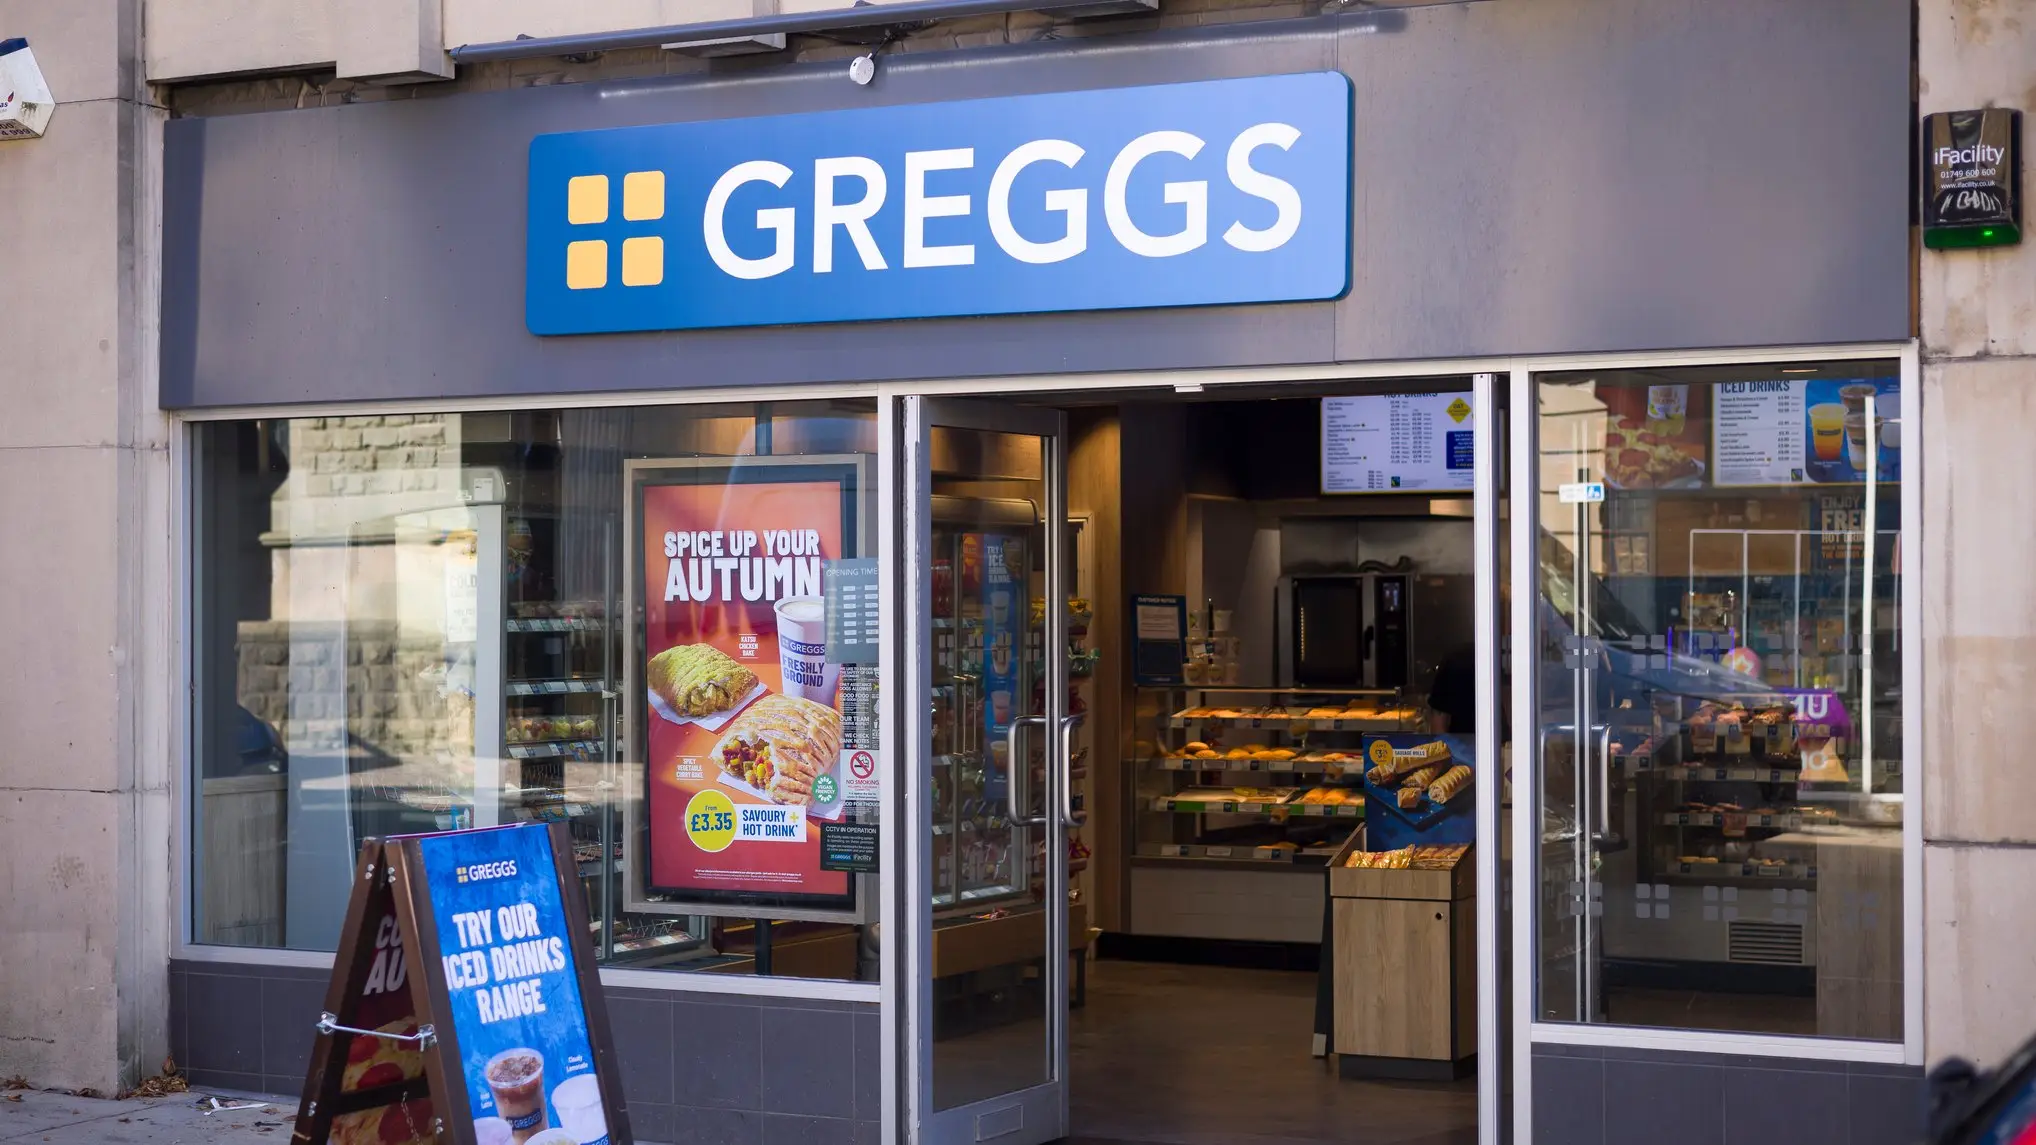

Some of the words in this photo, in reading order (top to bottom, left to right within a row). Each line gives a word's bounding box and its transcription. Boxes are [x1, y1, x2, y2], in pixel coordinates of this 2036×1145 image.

[1934, 145, 2004, 165] iFacility
[1940, 169, 1964, 179] 01749
[1965, 169, 1980, 178] 600
[1981, 168, 1996, 177] 600
[1940, 180, 1996, 189] www.ifacility.co.uk
[703, 122, 1302, 280] GREGGS
[1721, 381, 1745, 394] ICED
[1750, 380, 1790, 393] DRINKS
[664, 531, 724, 558] SPICE
[729, 530, 757, 557] UP
[763, 529, 820, 556] YOUR
[988, 555, 1006, 566] ICE
[664, 556, 822, 603] AUTUMN
[826, 568, 859, 577] OPENING
[861, 567, 878, 575] TIME
[790, 641, 825, 654] GREGGS
[783, 654, 825, 675] FRESHLY
[784, 667, 824, 688] GROUND
[690, 812, 733, 832] £3.35
[742, 810, 786, 823] SAVOURY
[743, 824, 762, 836] HOT
[468, 860, 518, 882] GREGGS
[452, 909, 493, 949] TRY
[497, 902, 541, 942] OUR
[363, 947, 408, 995] AU
[442, 950, 488, 991] ICED
[490, 936, 566, 982] DRINKS
[476, 979, 546, 1024] RANGE
[513, 1111, 543, 1129] GREGGS
